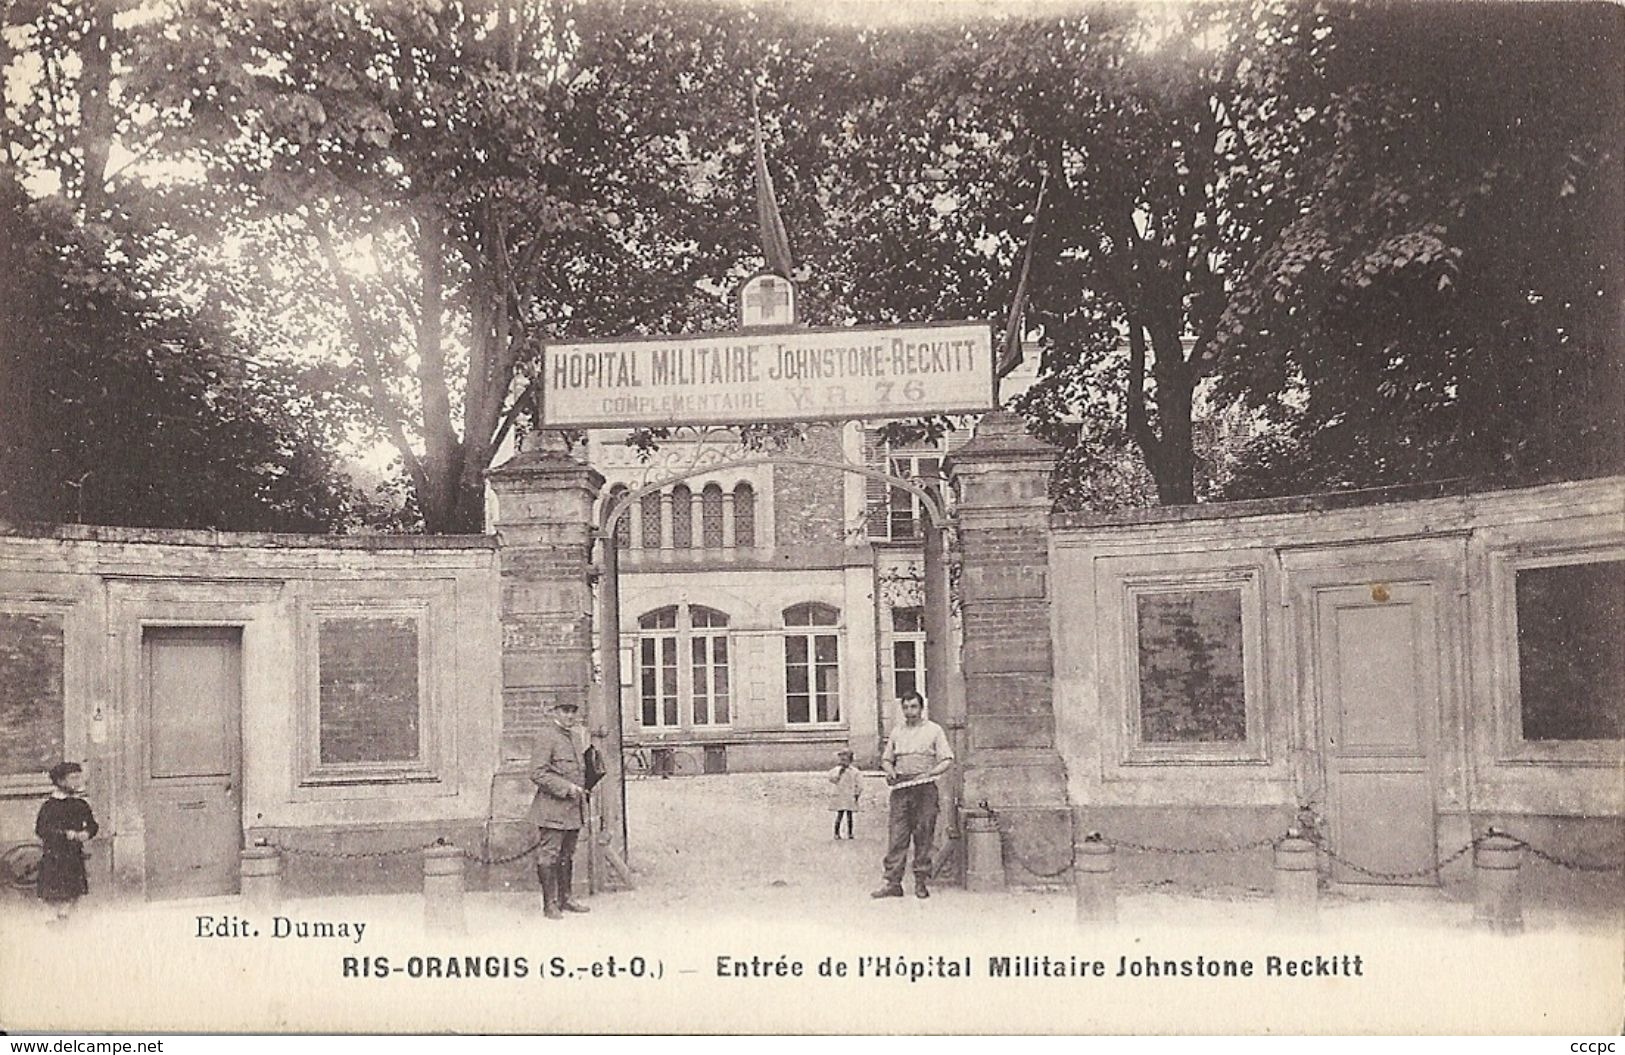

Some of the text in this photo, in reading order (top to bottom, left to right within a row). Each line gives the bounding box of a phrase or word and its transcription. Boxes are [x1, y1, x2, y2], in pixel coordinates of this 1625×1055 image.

[553, 348, 642, 390] HÔPITAL
[652, 345, 760, 386] MILITAIRE
[874, 379, 926, 403] 76
